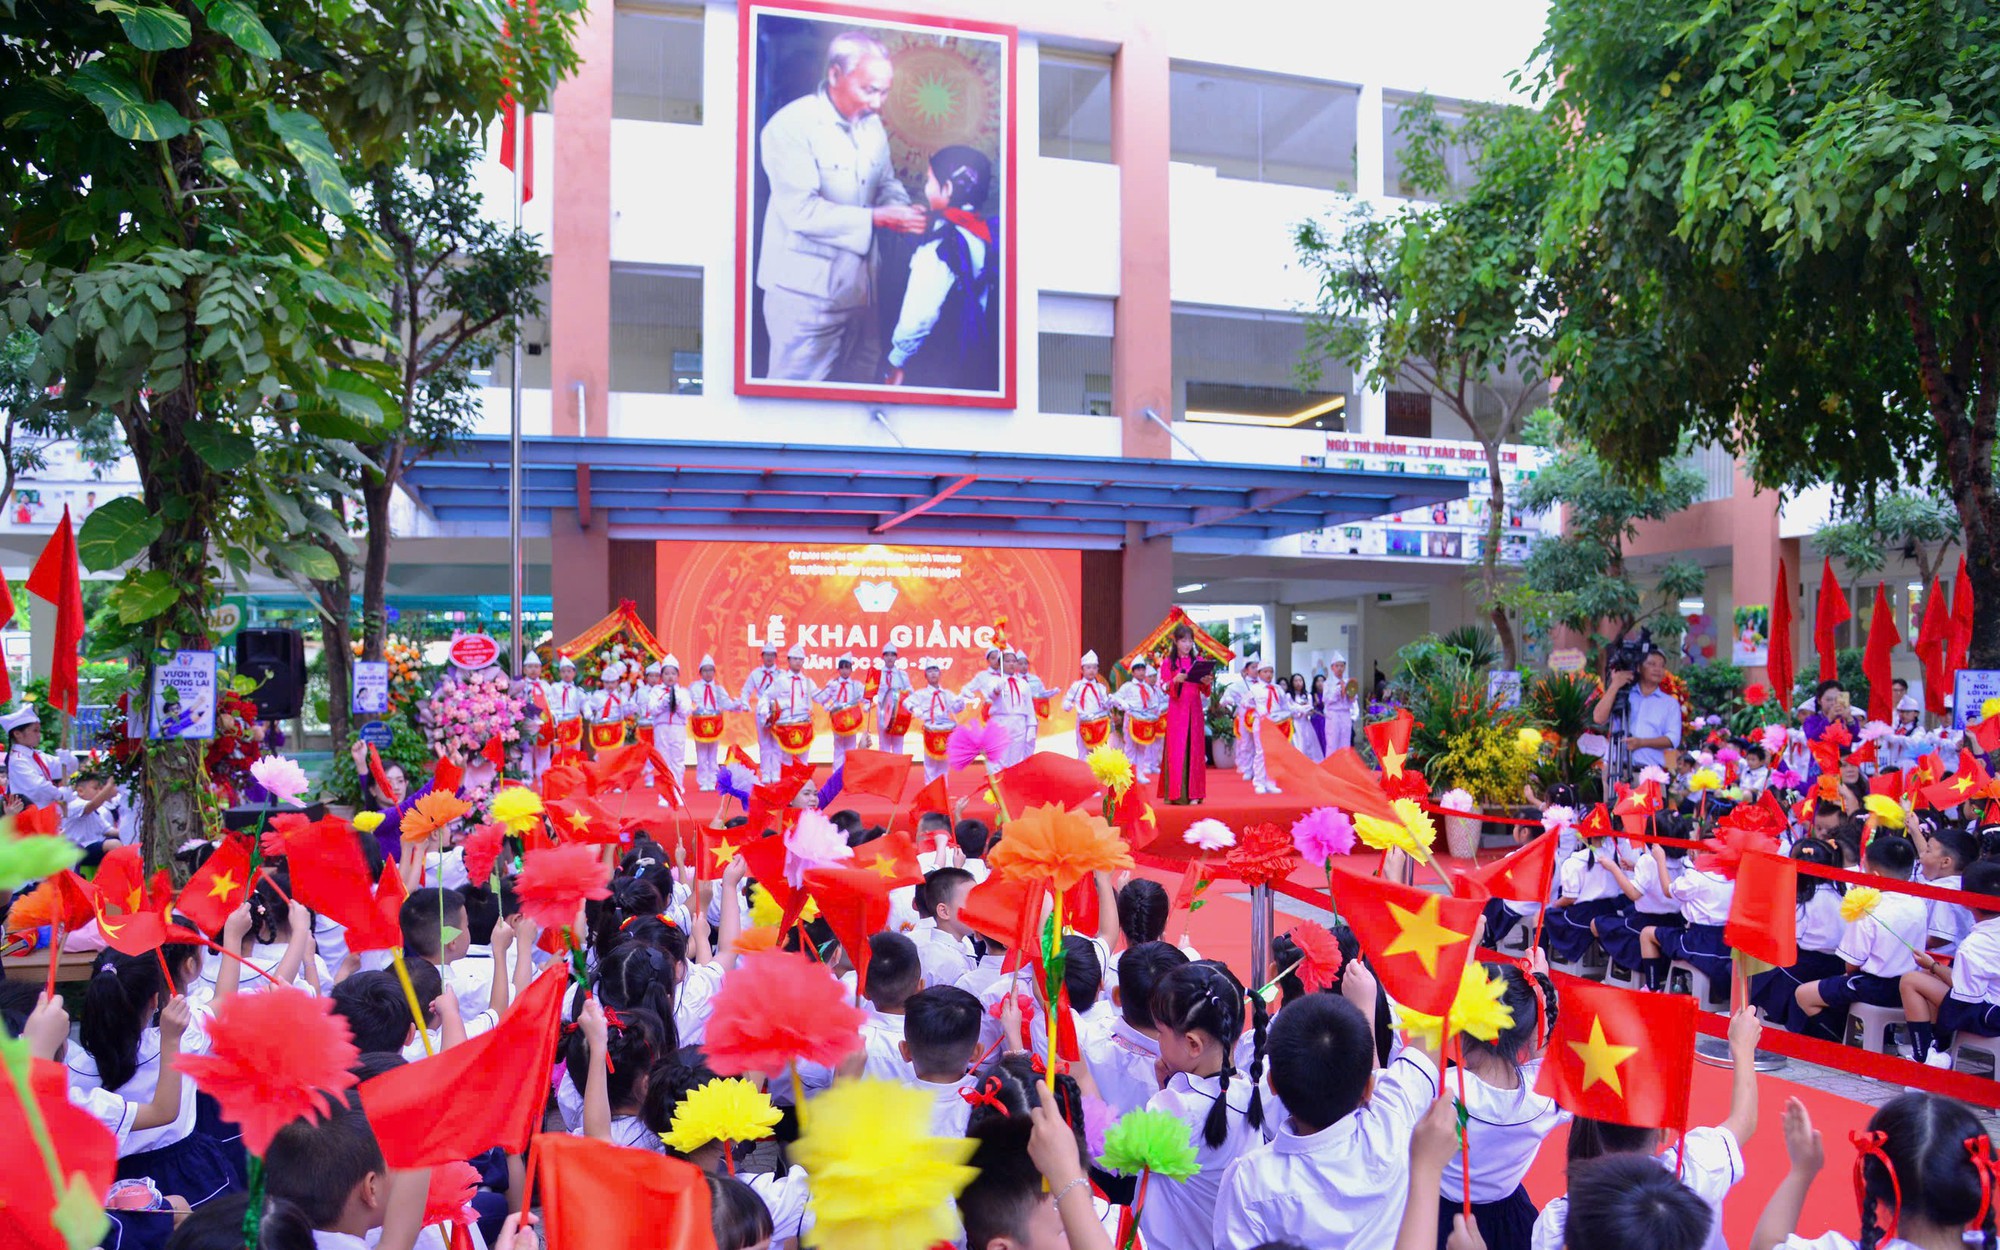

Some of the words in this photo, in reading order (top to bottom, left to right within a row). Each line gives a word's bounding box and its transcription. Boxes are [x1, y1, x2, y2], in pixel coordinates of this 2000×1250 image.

[747, 614, 786, 647] LỄ
[797, 624, 878, 648] KHAI
[890, 619, 996, 649] GIẢNG
[196, 679, 210, 687] LAI
